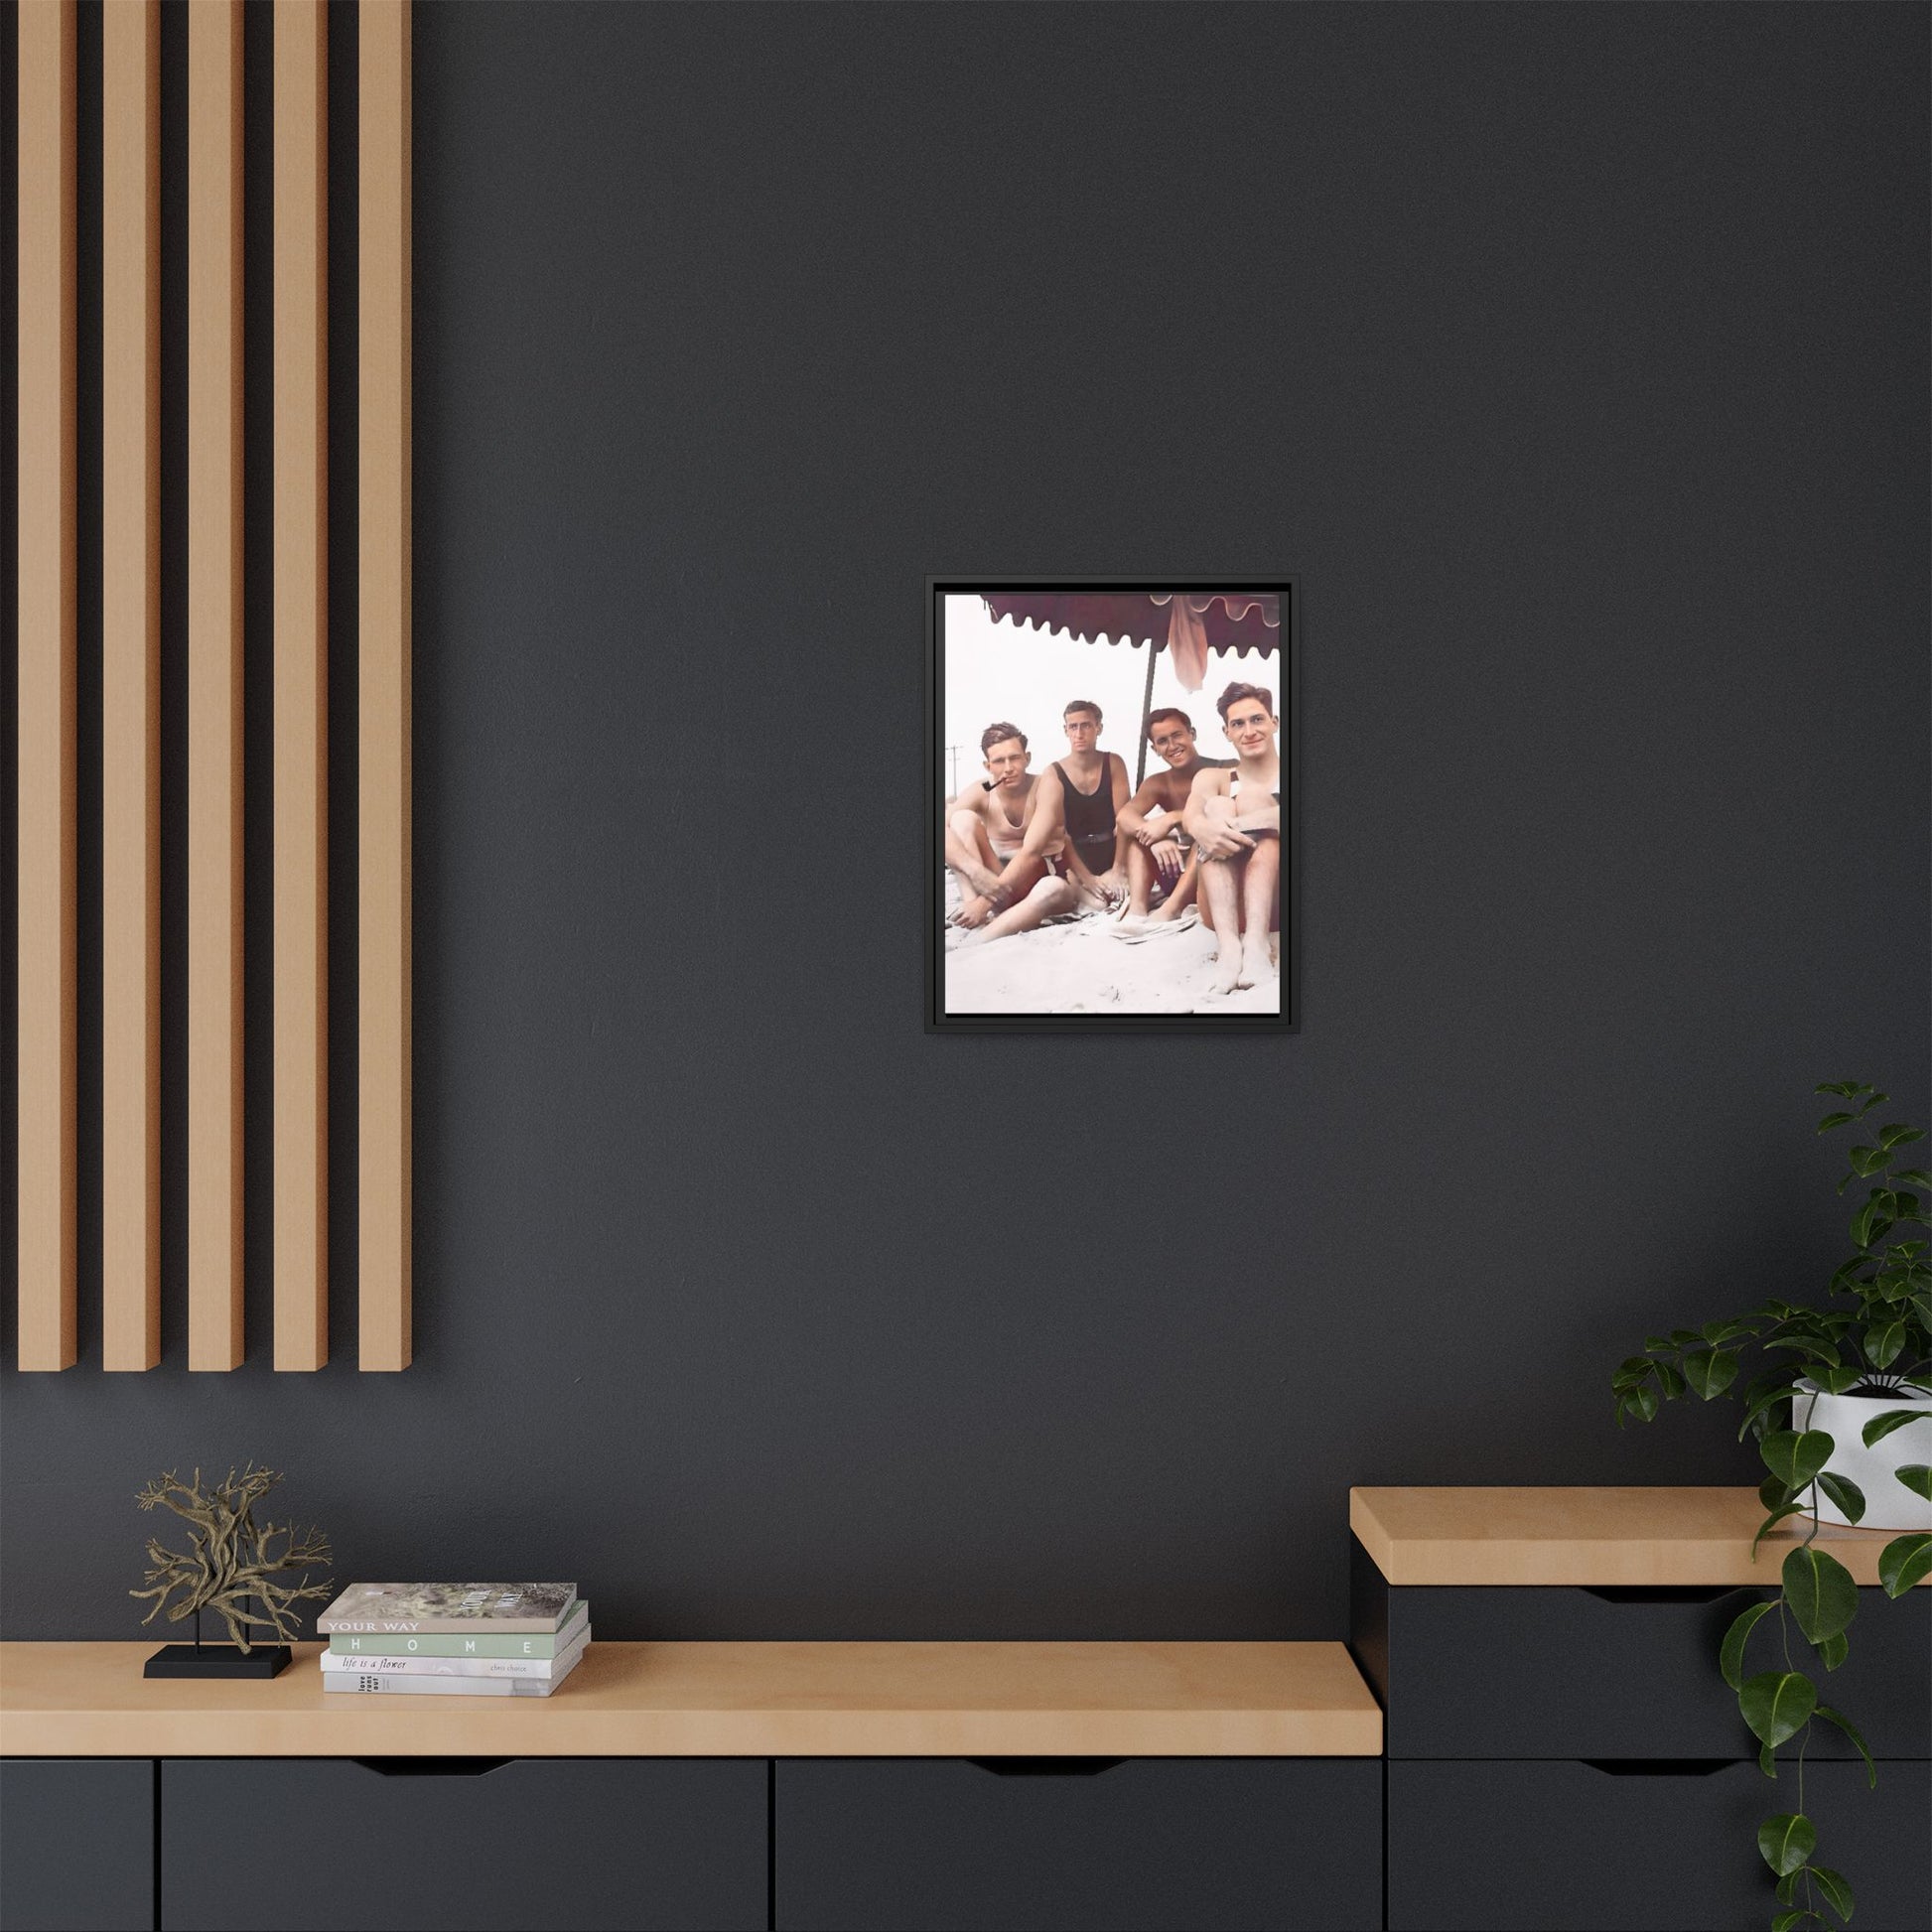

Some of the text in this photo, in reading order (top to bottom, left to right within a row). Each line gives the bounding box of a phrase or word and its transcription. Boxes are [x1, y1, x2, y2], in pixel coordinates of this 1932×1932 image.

[328, 1622, 420, 1631] YOUR WAY
[343, 1657, 357, 1670] life
[359, 1659, 367, 1668] is
[377, 1658, 406, 1671] flower
